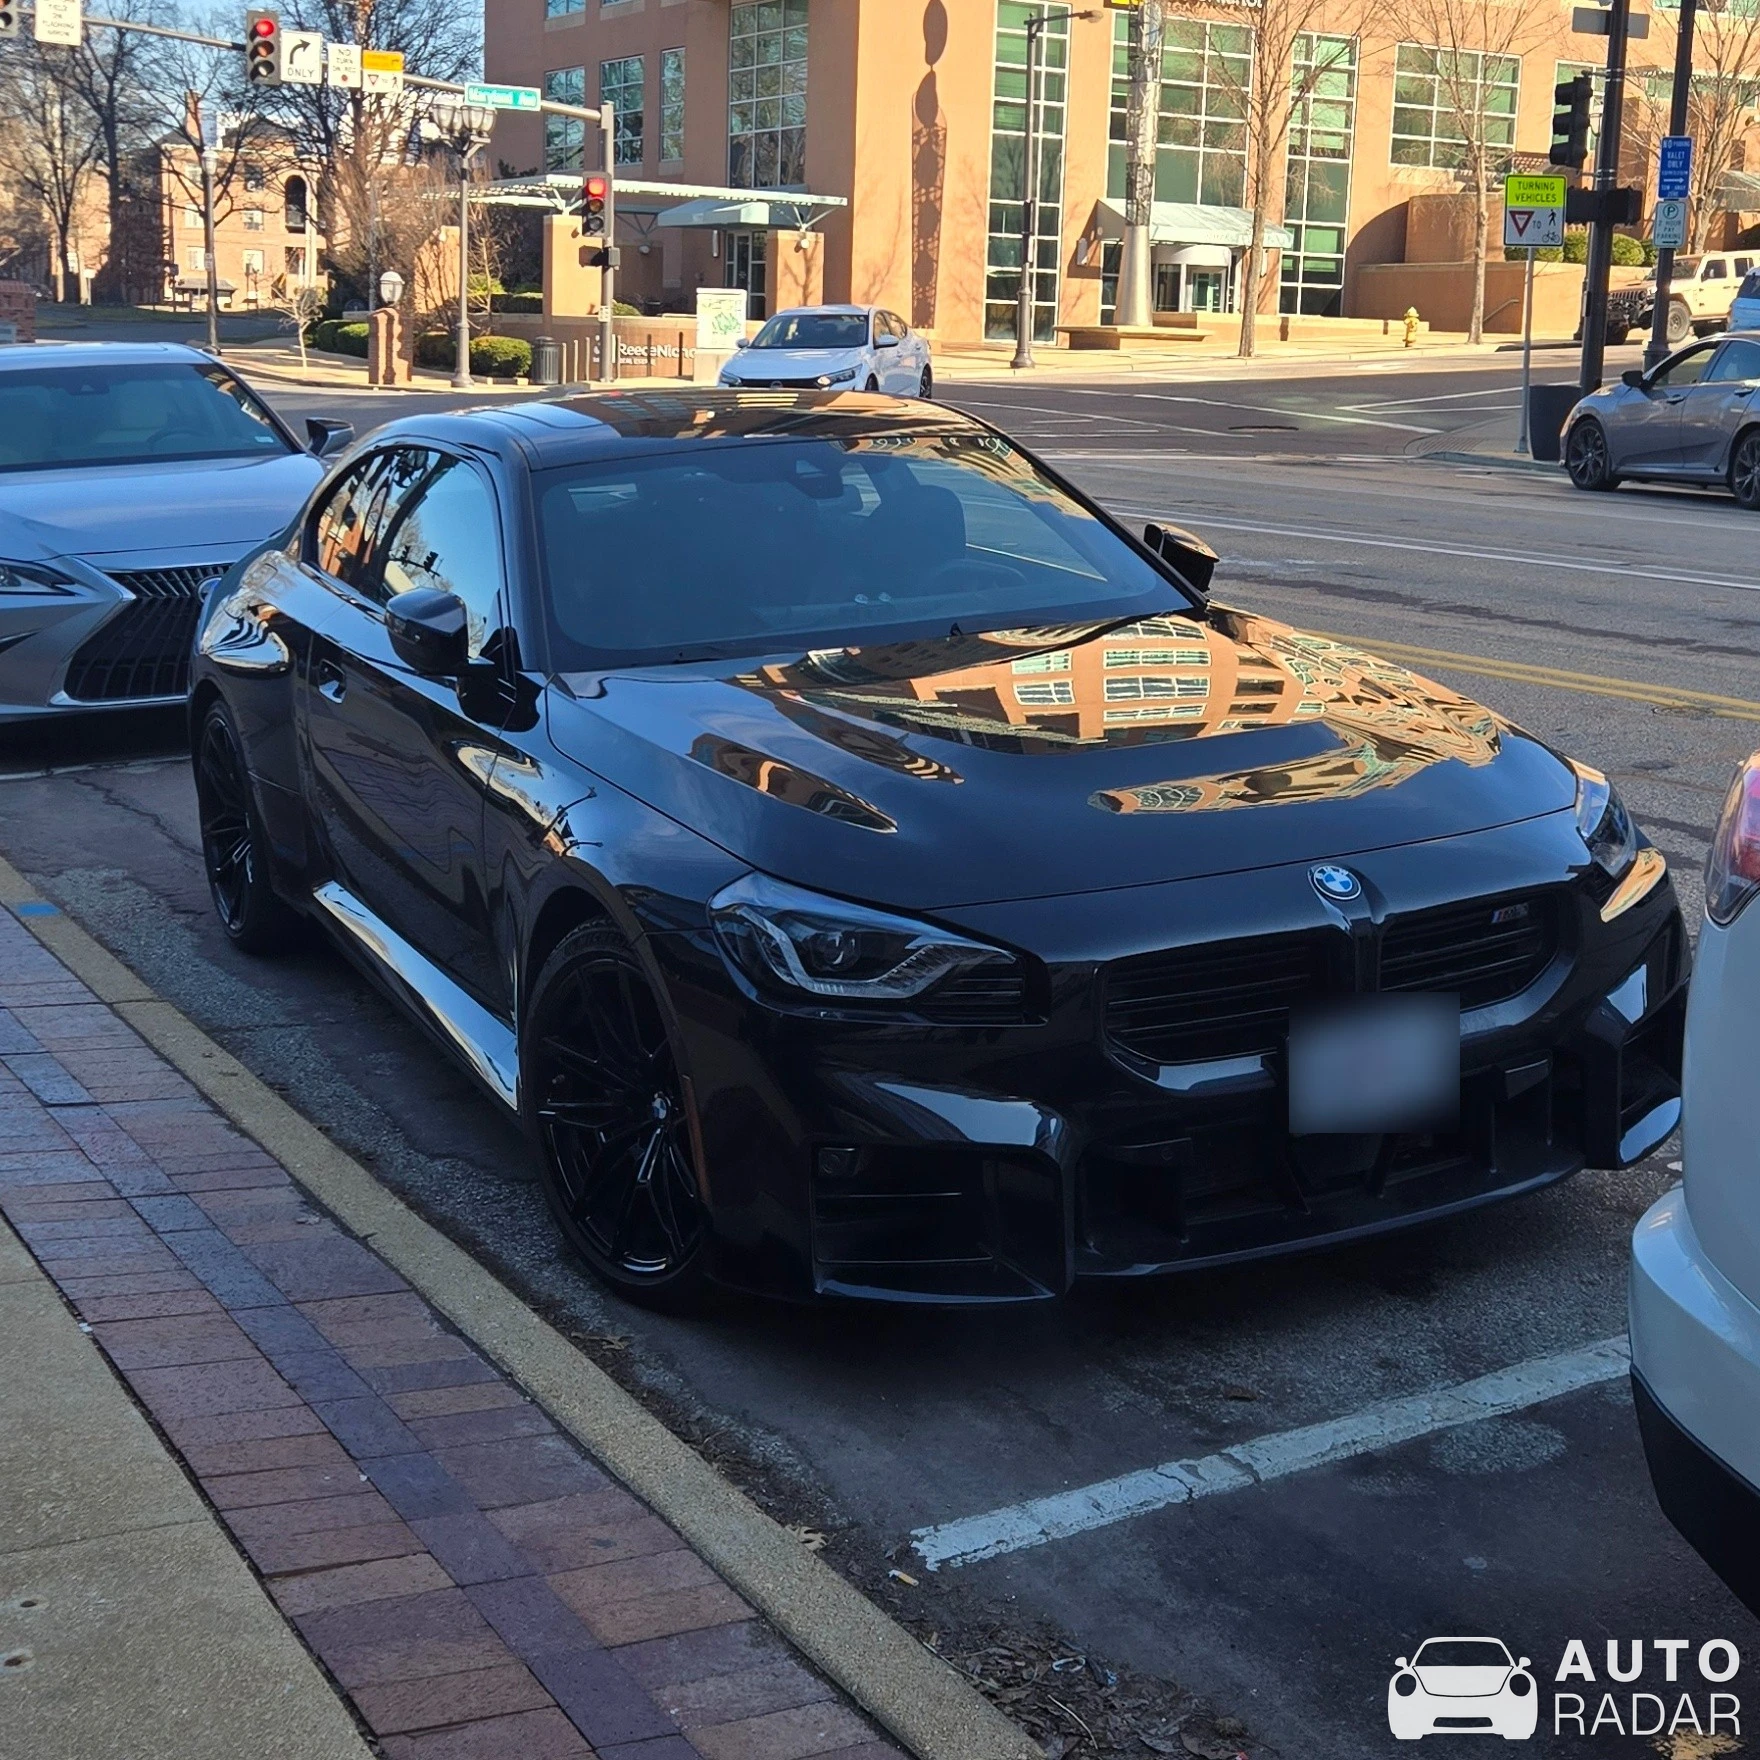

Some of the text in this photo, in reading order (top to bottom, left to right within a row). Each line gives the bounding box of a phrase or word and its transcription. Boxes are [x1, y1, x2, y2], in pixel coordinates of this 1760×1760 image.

[338, 48, 352, 56] NO
[287, 67, 315, 78] ONLY
[1667, 151, 1685, 159] VALET
[1667, 160, 1683, 168] ONLY
[1517, 181, 1555, 191] TURNING
[1515, 193, 1557, 203] VEHICLES
[1532, 220, 1542, 229] TO
